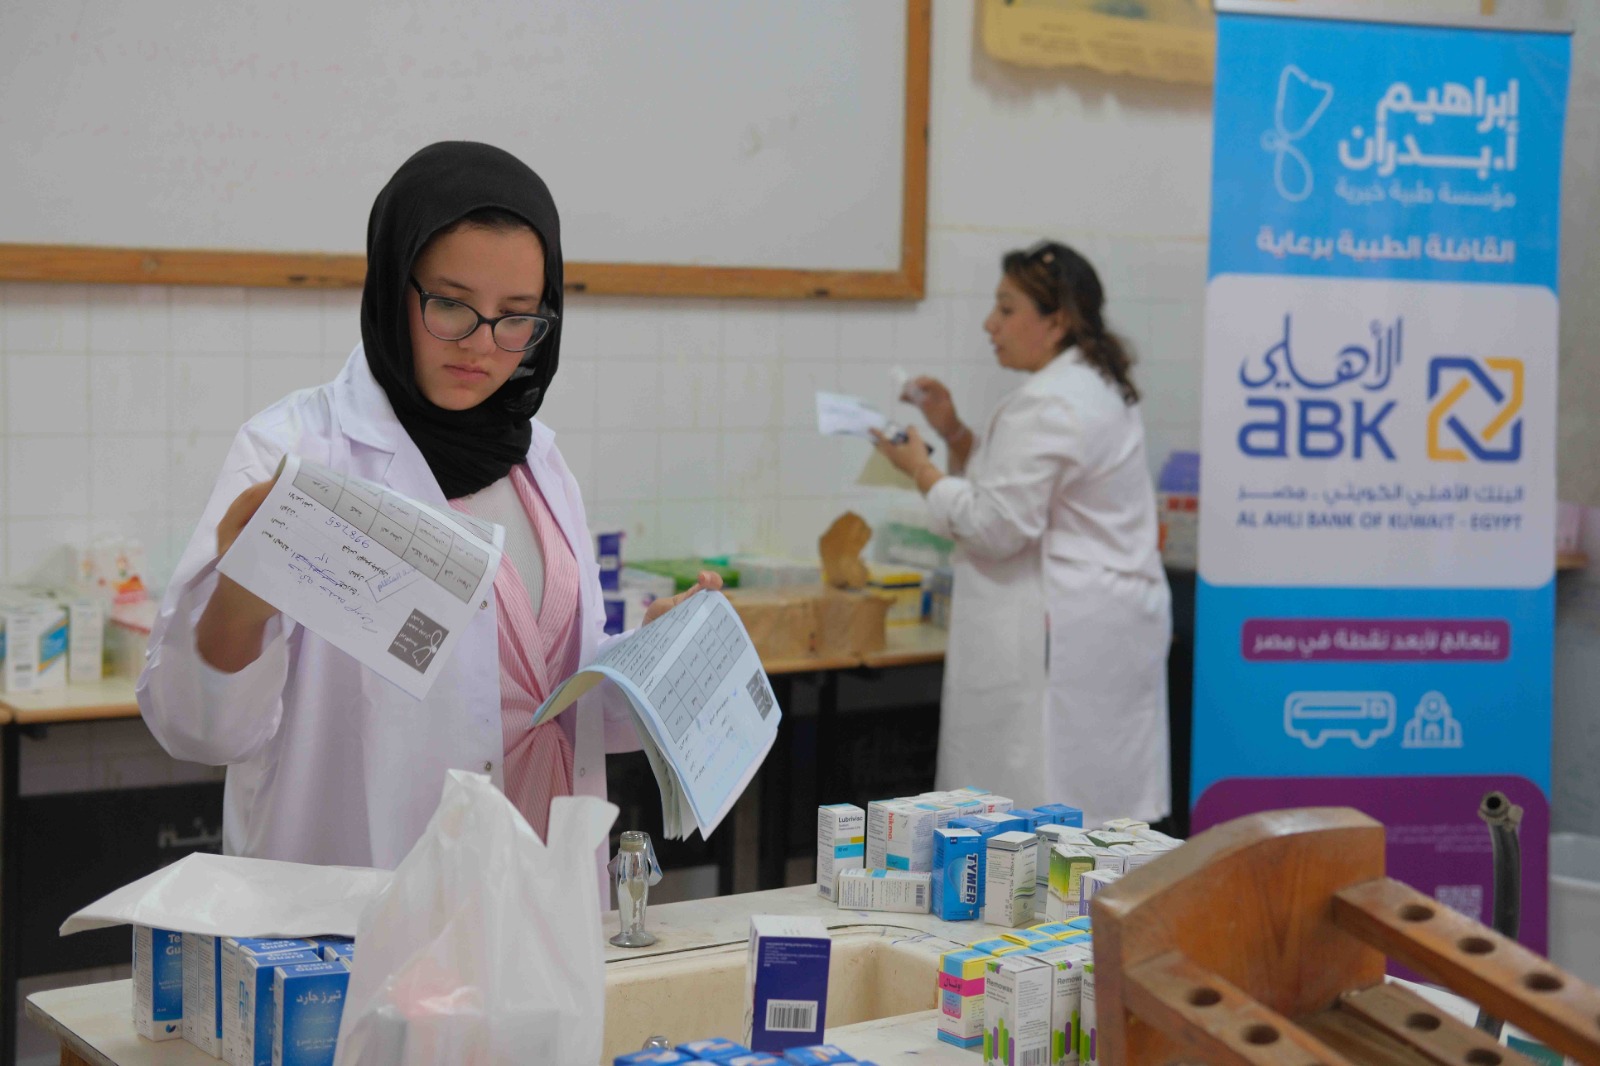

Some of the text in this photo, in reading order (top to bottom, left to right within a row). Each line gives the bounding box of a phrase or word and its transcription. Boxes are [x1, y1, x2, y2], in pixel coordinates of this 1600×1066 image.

[1376, 76, 1519, 133] إبراهيم
[1335, 175, 1516, 210] مؤسسة طبية خيرية
[1256, 225, 1514, 263] القافلة الطبية برعاية
[1322, 483, 1403, 506] الكويتي
[1406, 483, 1471, 507] الأهلي
[1473, 484, 1526, 503] البنك
[271, 518, 286, 528] السن
[1237, 511, 1523, 530] AL AHLI BANK OF KUWAIT EGYPT
[349, 570, 364, 580] الطول
[1252, 632, 1297, 654] مصر
[1332, 627, 1390, 652] نقطة
[967, 854, 977, 904] TYMER
[986, 977, 1013, 994] Remowax
[296, 990, 319, 1005] جارد
